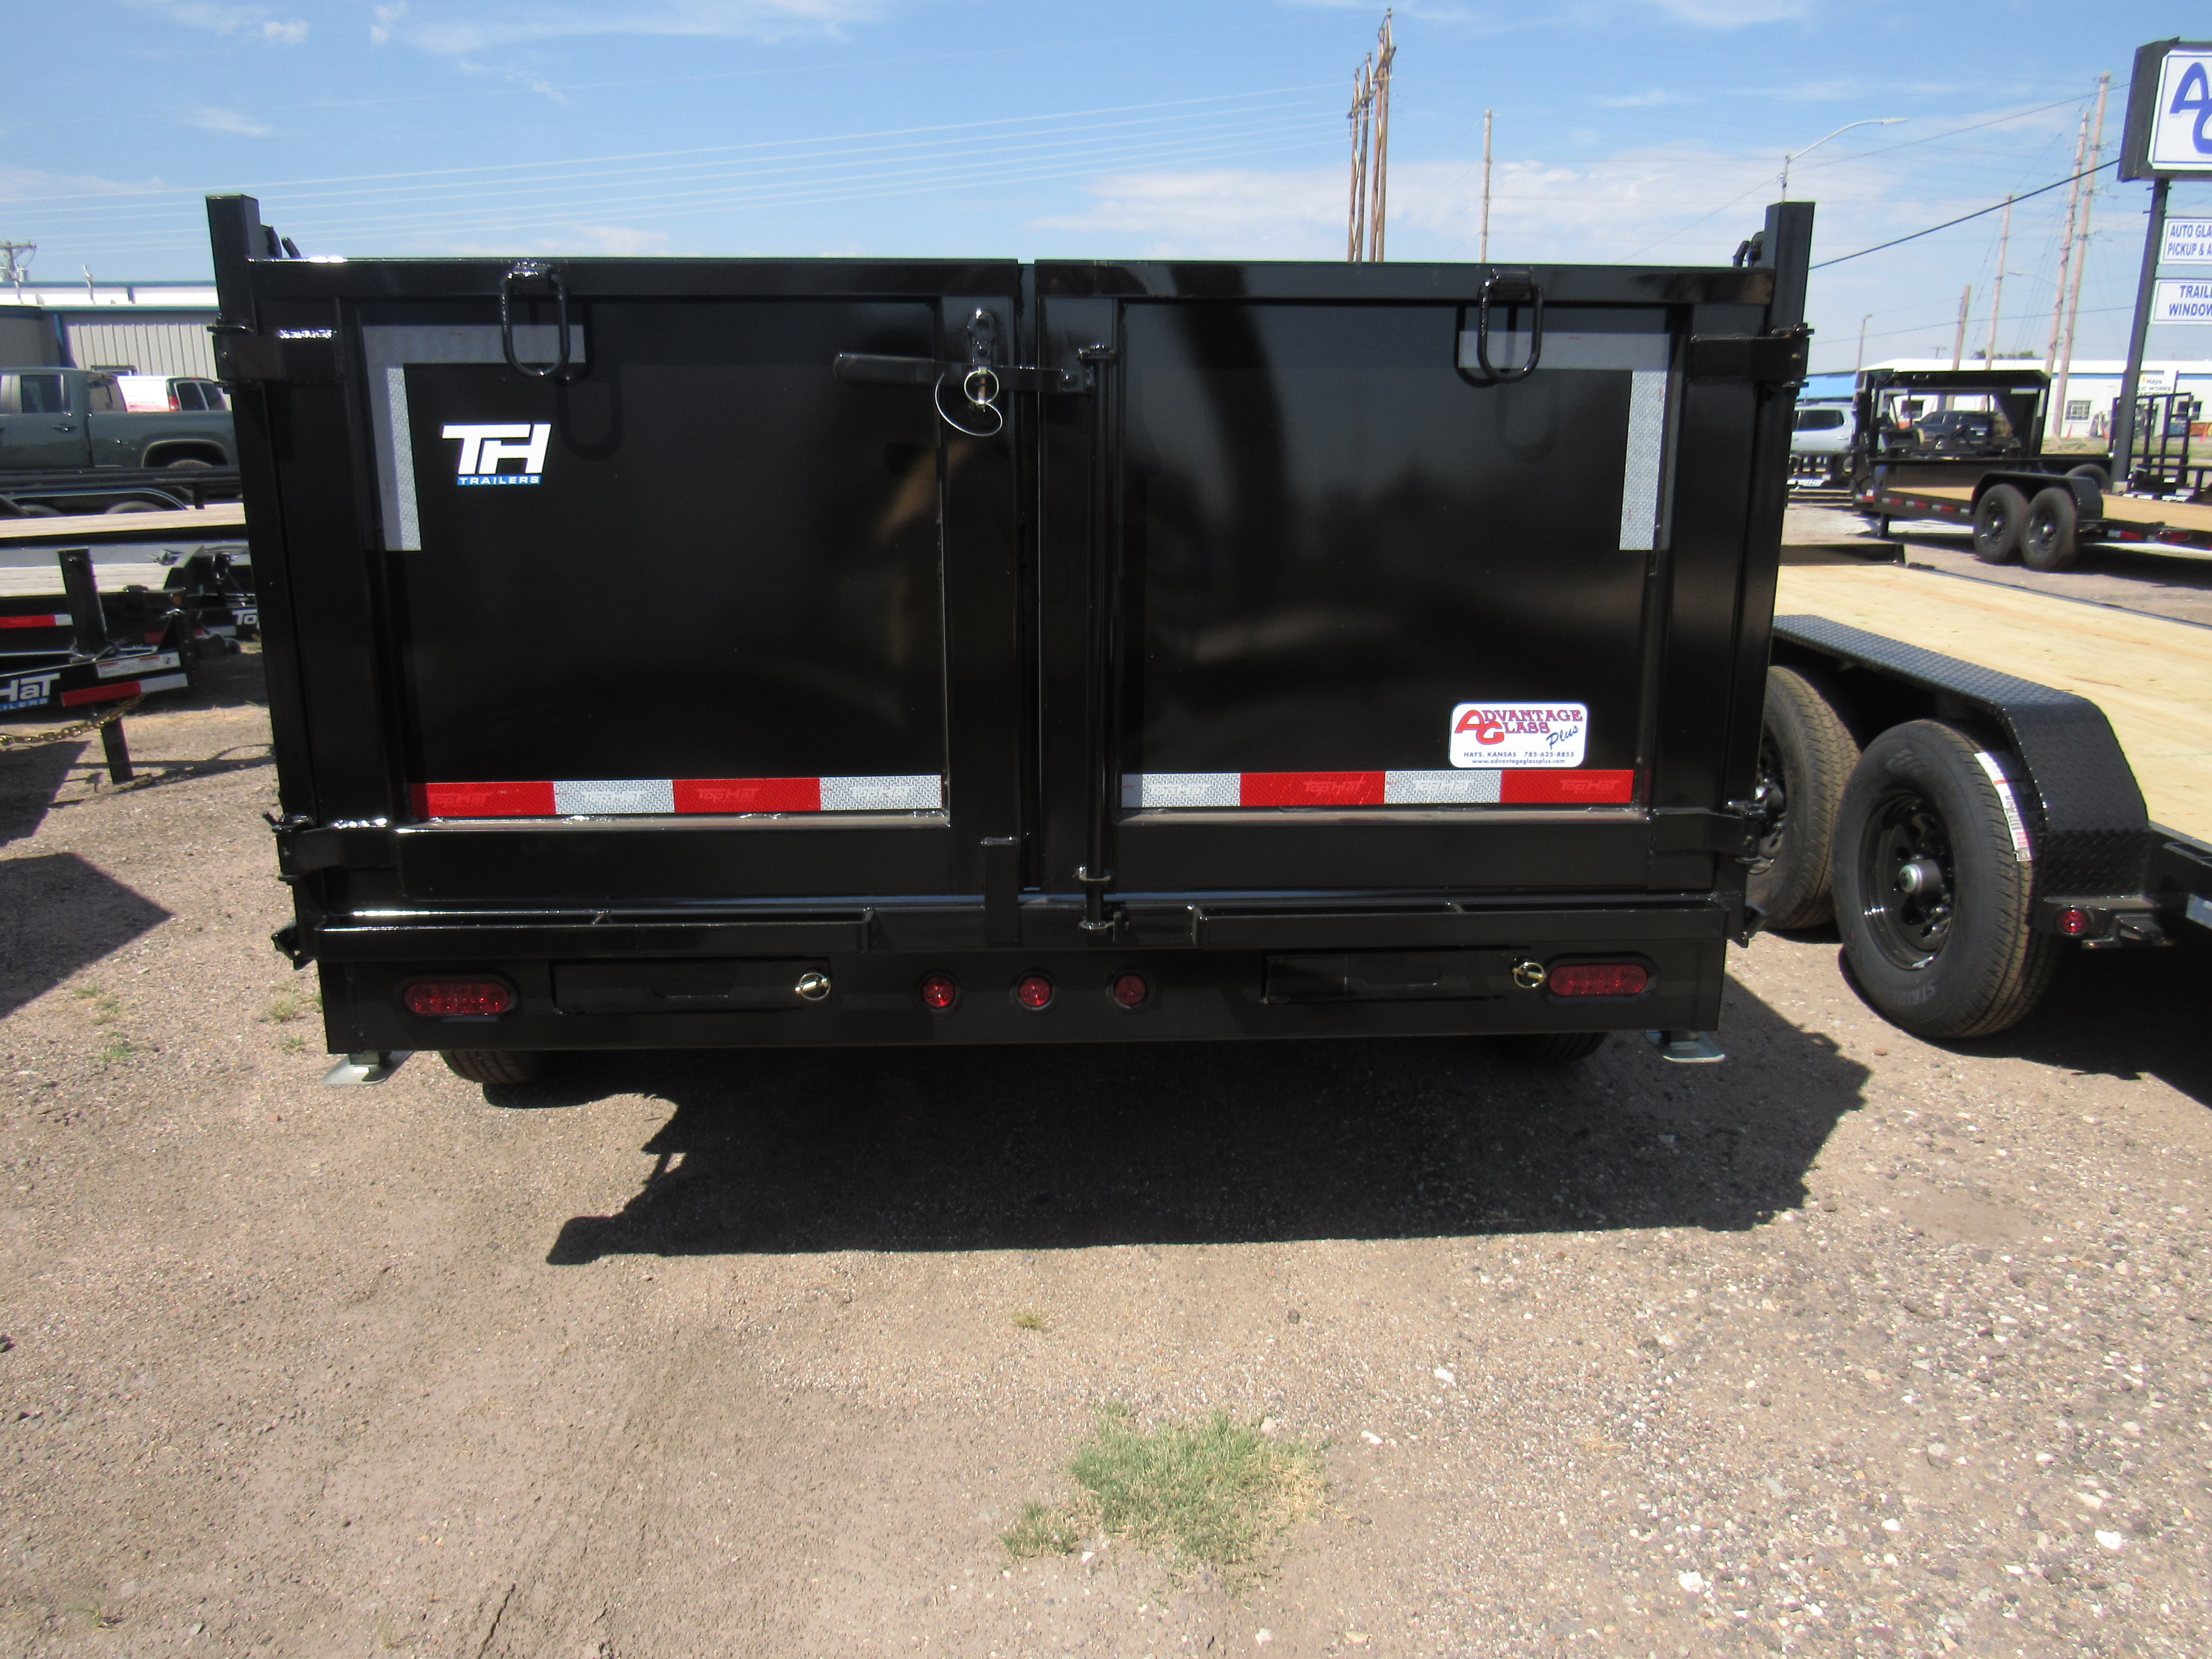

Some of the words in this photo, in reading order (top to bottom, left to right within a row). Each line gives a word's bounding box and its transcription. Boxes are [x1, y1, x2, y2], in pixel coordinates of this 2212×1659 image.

[2169, 225, 2193, 238] AUTO
[2167, 243, 2197, 256] PICKUP
[2199, 243, 2204, 256] &
[459, 476, 540, 485] TRAILERS
[1455, 709, 1583, 733] ADVANTAGE
[1476, 721, 1551, 745] GLASS
[1546, 725, 1579, 750] Plus
